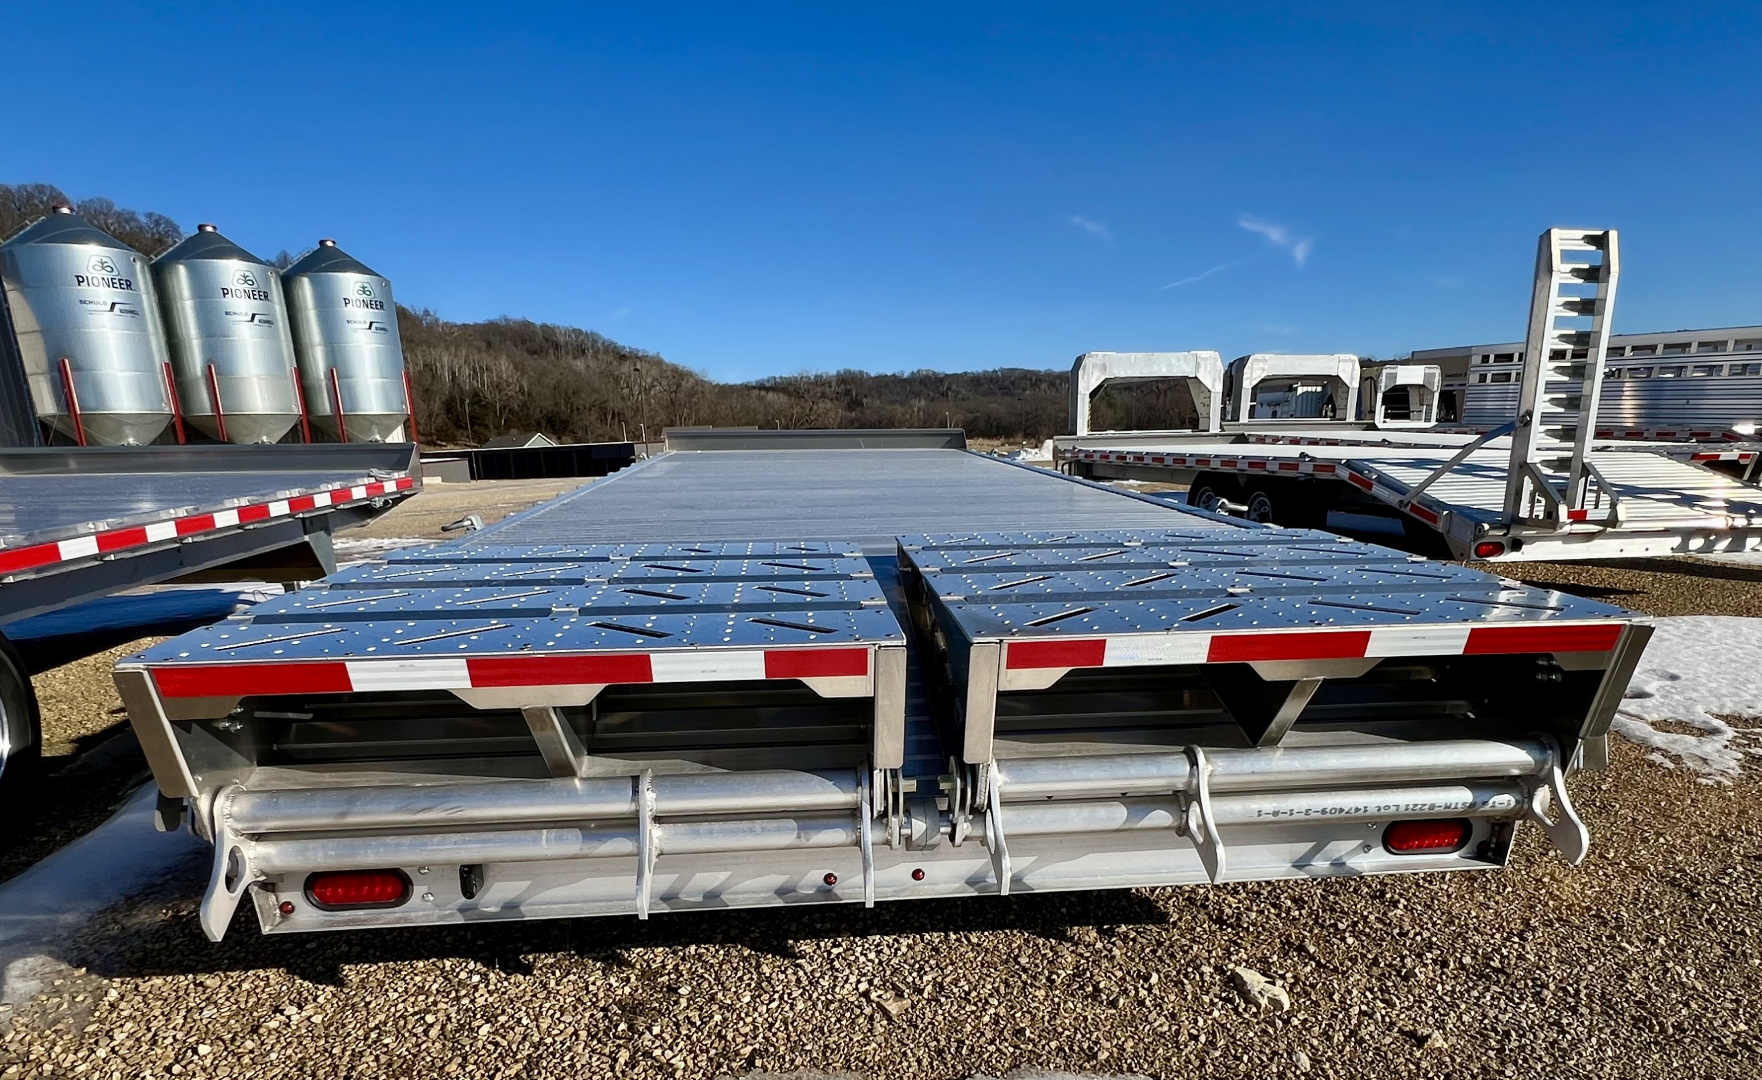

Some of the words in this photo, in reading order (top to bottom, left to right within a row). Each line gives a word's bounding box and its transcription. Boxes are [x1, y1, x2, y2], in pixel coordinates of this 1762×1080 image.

[74, 274, 133, 291] PIONEER
[220, 287, 270, 302] PIONEER
[343, 297, 385, 312] PIONEER
[1375, 803, 1401, 813] Lot
